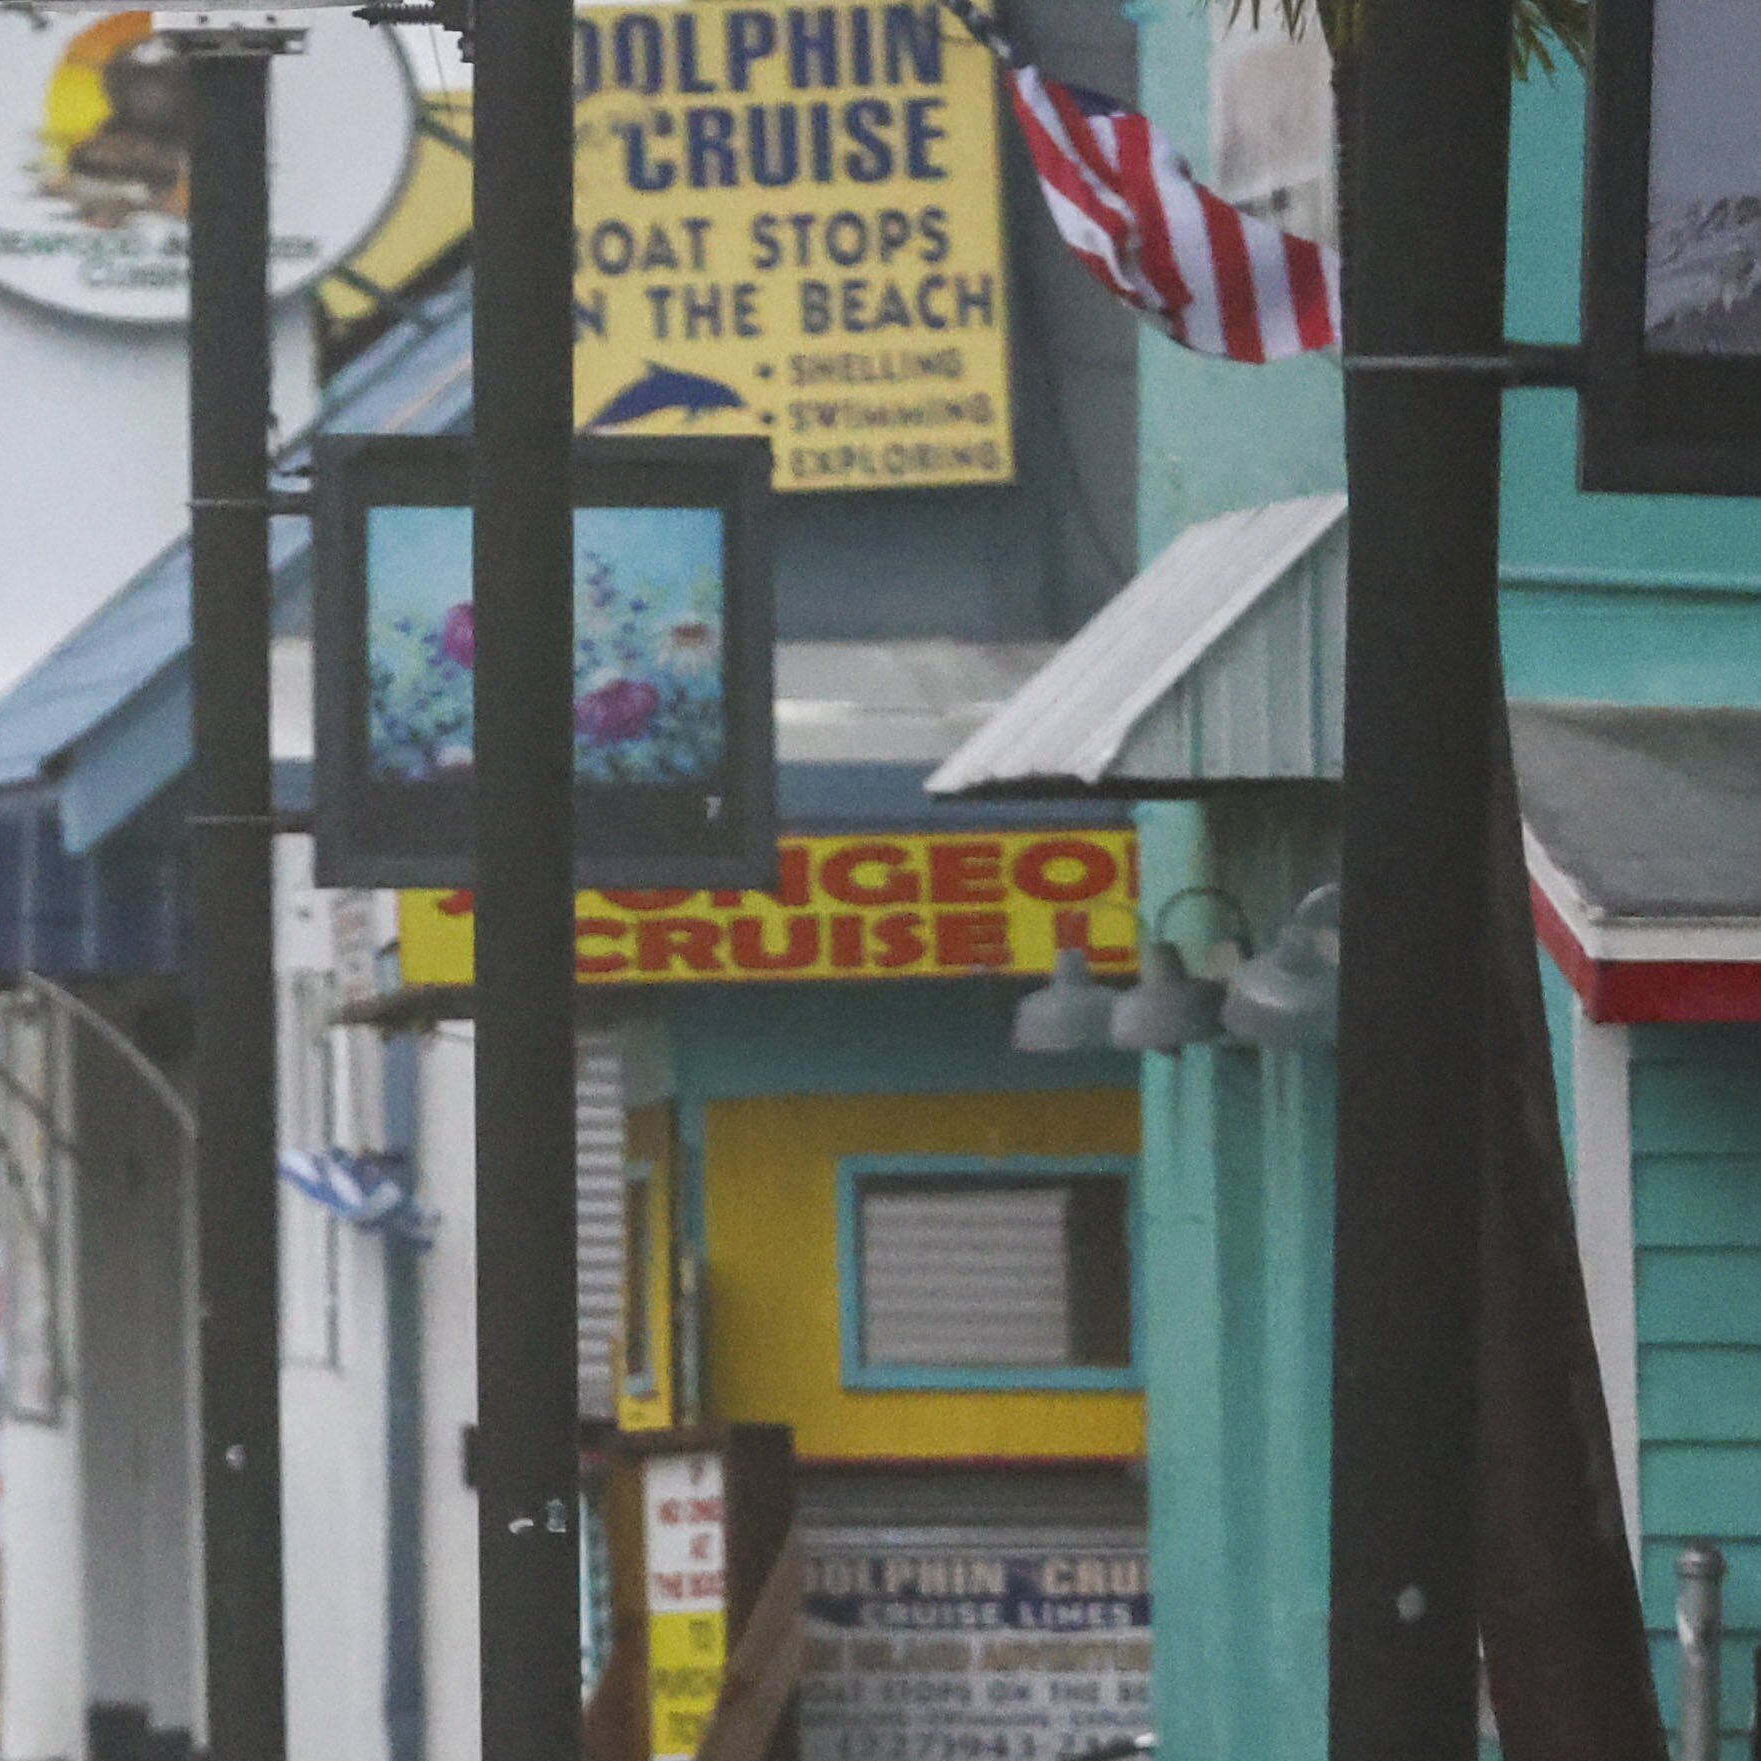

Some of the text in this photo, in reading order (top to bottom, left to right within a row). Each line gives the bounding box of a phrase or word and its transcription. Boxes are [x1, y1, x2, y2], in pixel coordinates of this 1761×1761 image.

[627, 98, 949, 191] CRUISE
[574, 204, 949, 276] OAT STOPS
[574, 264, 995, 342] N THE BEACH
[1039, 1555, 1144, 1597] CRU
